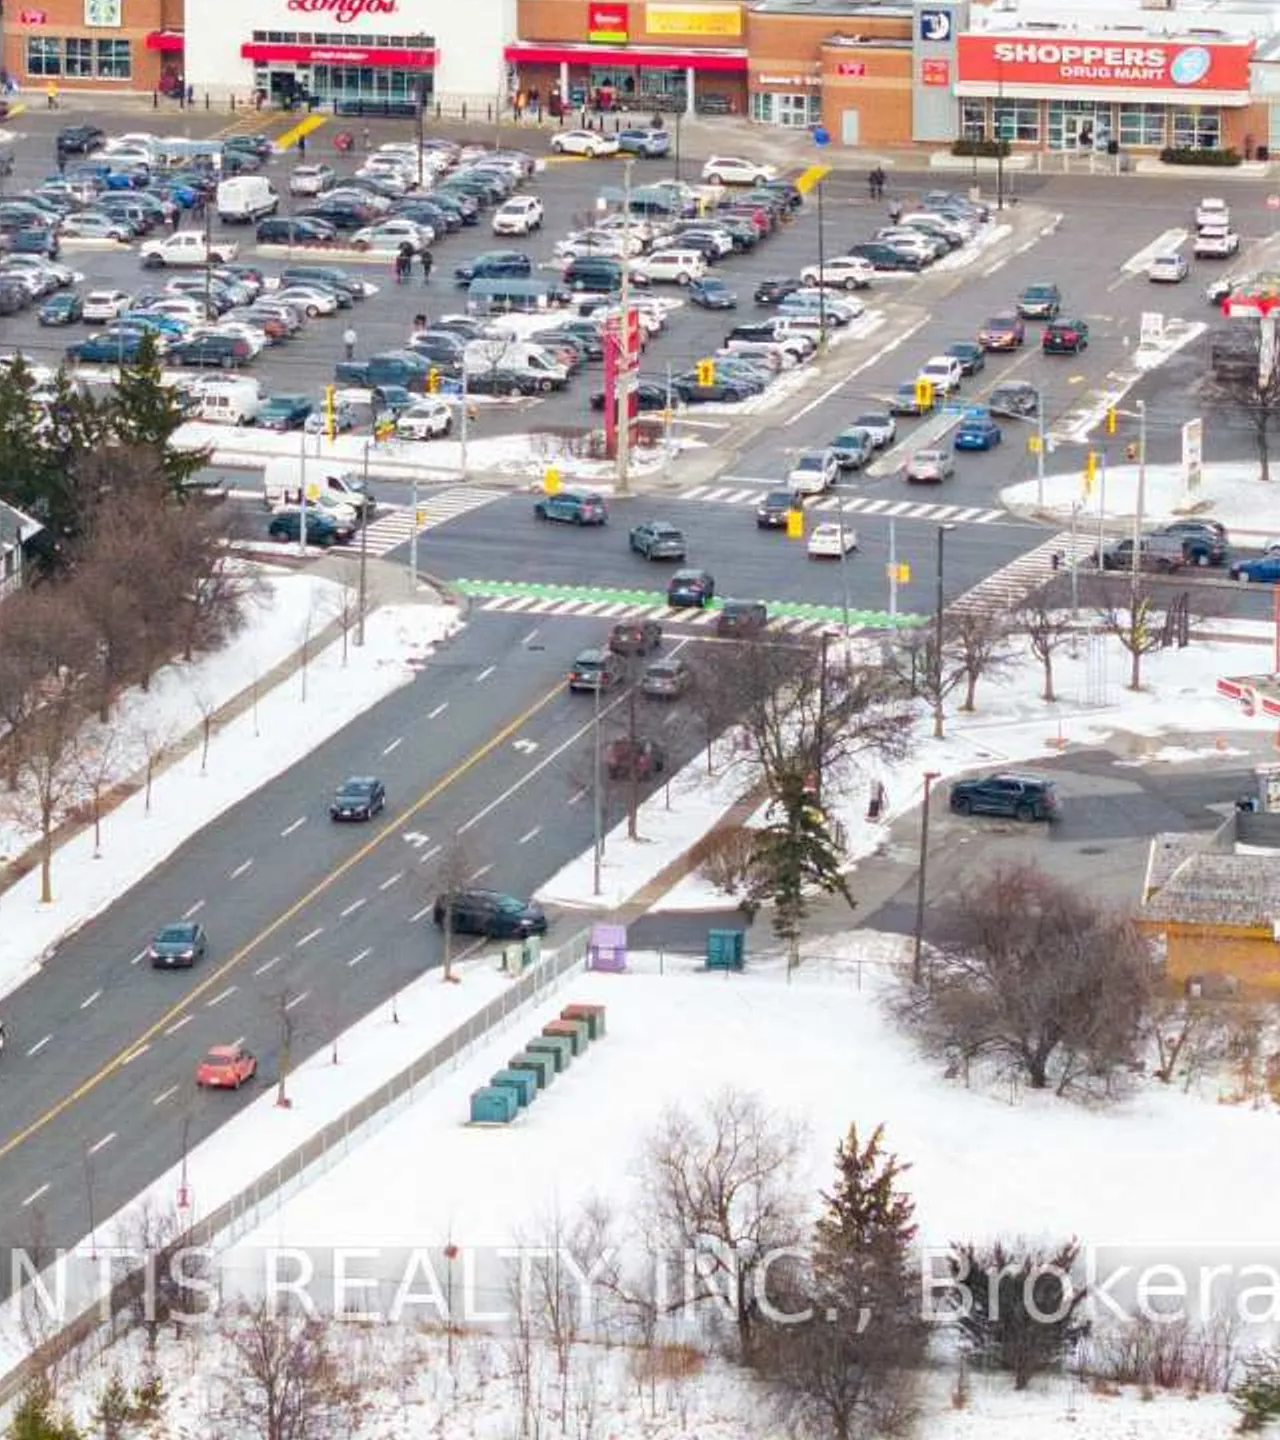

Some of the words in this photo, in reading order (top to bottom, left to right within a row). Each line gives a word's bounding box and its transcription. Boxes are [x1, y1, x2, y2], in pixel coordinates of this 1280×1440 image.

[994, 43, 1166, 67] SHOPPERS
[1060, 66, 1112, 79] DRUG
[1114, 68, 1165, 80] MART
